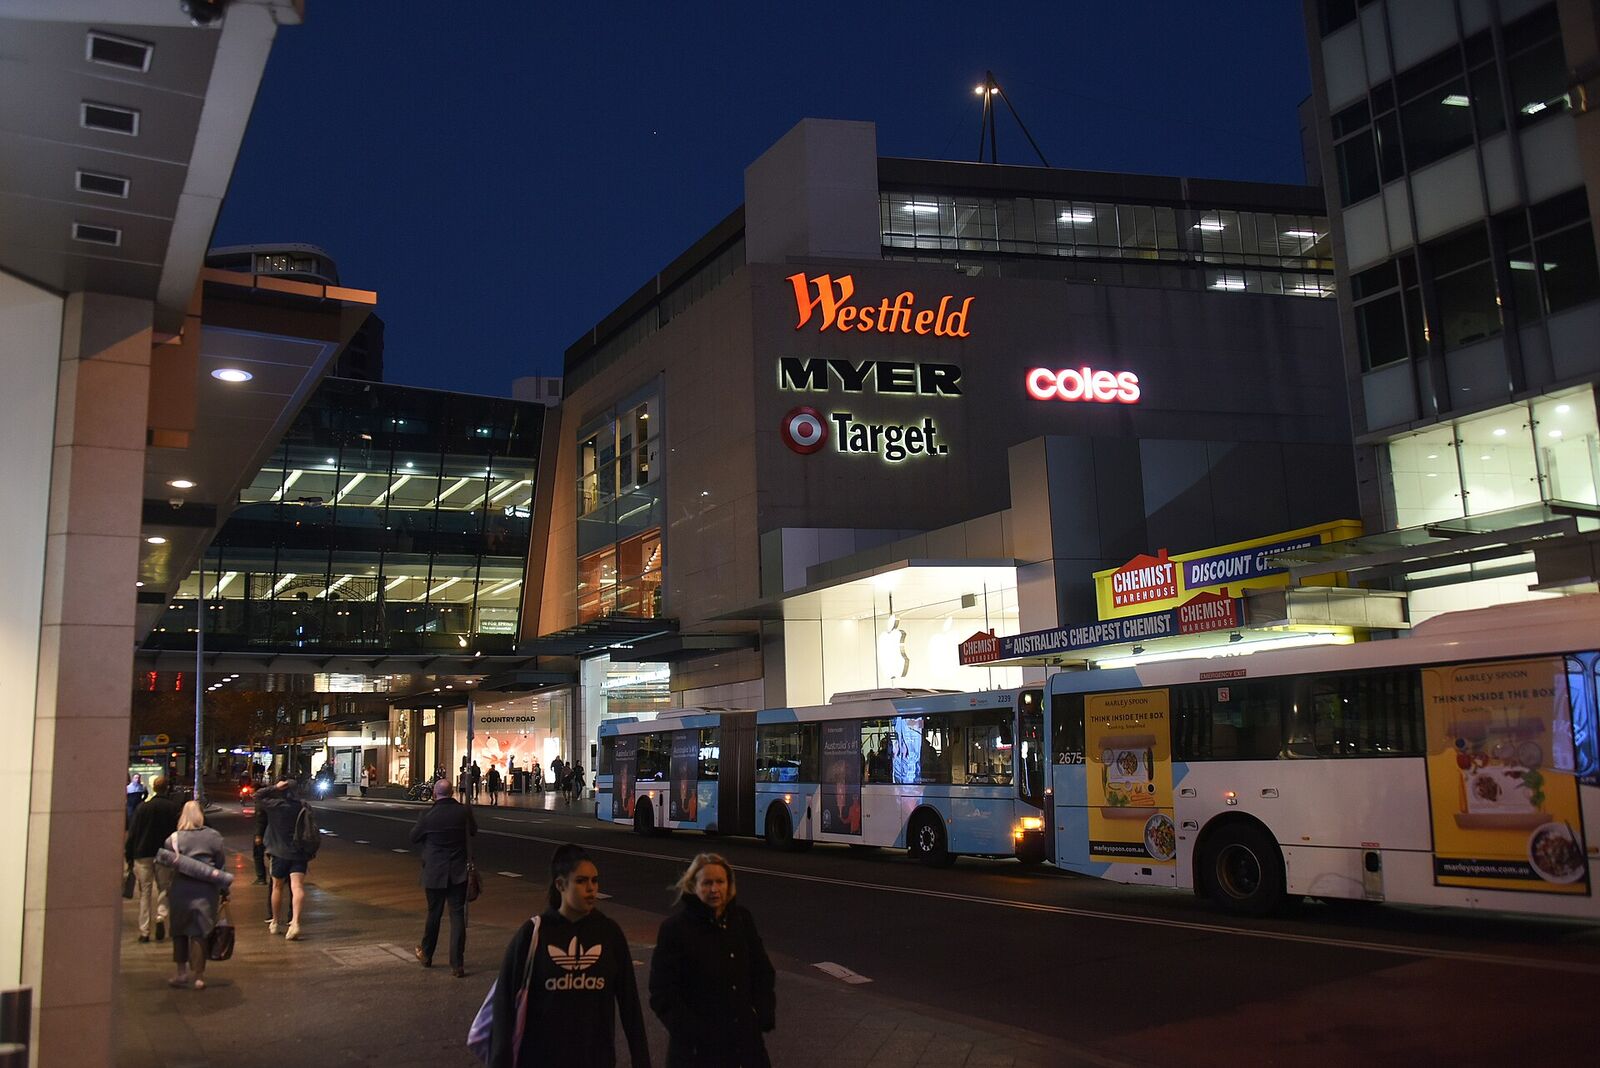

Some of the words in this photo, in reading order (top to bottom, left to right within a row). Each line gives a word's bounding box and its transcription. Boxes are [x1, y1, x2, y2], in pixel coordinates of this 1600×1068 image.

[786, 272, 975, 338] Westfield
[780, 357, 963, 396] MYER
[1028, 367, 1141, 401] coles
[1114, 562, 1173, 592] CHEMIST
[1192, 554, 1252, 584] DISCOUNT
[1116, 586, 1176, 605] WAREHOUSE
[1181, 600, 1232, 623] CHEMIST
[1182, 617, 1234, 633] WAREHOUSE
[1013, 630, 1068, 654] AUSTRALIA'S
[1070, 622, 1121, 647] CHEAPEST
[1123, 614, 1171, 638] CHEMIST
[963, 638, 997, 655] CHEMIST
[1200, 671, 1233, 680] EMERGENCY
[1455, 673, 1493, 684] MARLEY
[1495, 670, 1528, 680] SPOON
[1432, 693, 1465, 704] THINK
[1467, 691, 1505, 702] INSIDE
[1507, 689, 1529, 700] THE
[1532, 687, 1556, 698] BOX
[1091, 715, 1111, 723] THINK
[1111, 713, 1133, 721] INSIDE
[1134, 712, 1148, 720] THE
[1149, 711, 1164, 719] BOX
[1059, 752, 1083, 764] 2675
[1093, 845, 1145, 853] marleyspoon.com.au
[1443, 863, 1530, 874] marleyspoon.com.au
[545, 973, 604, 990] adidas
